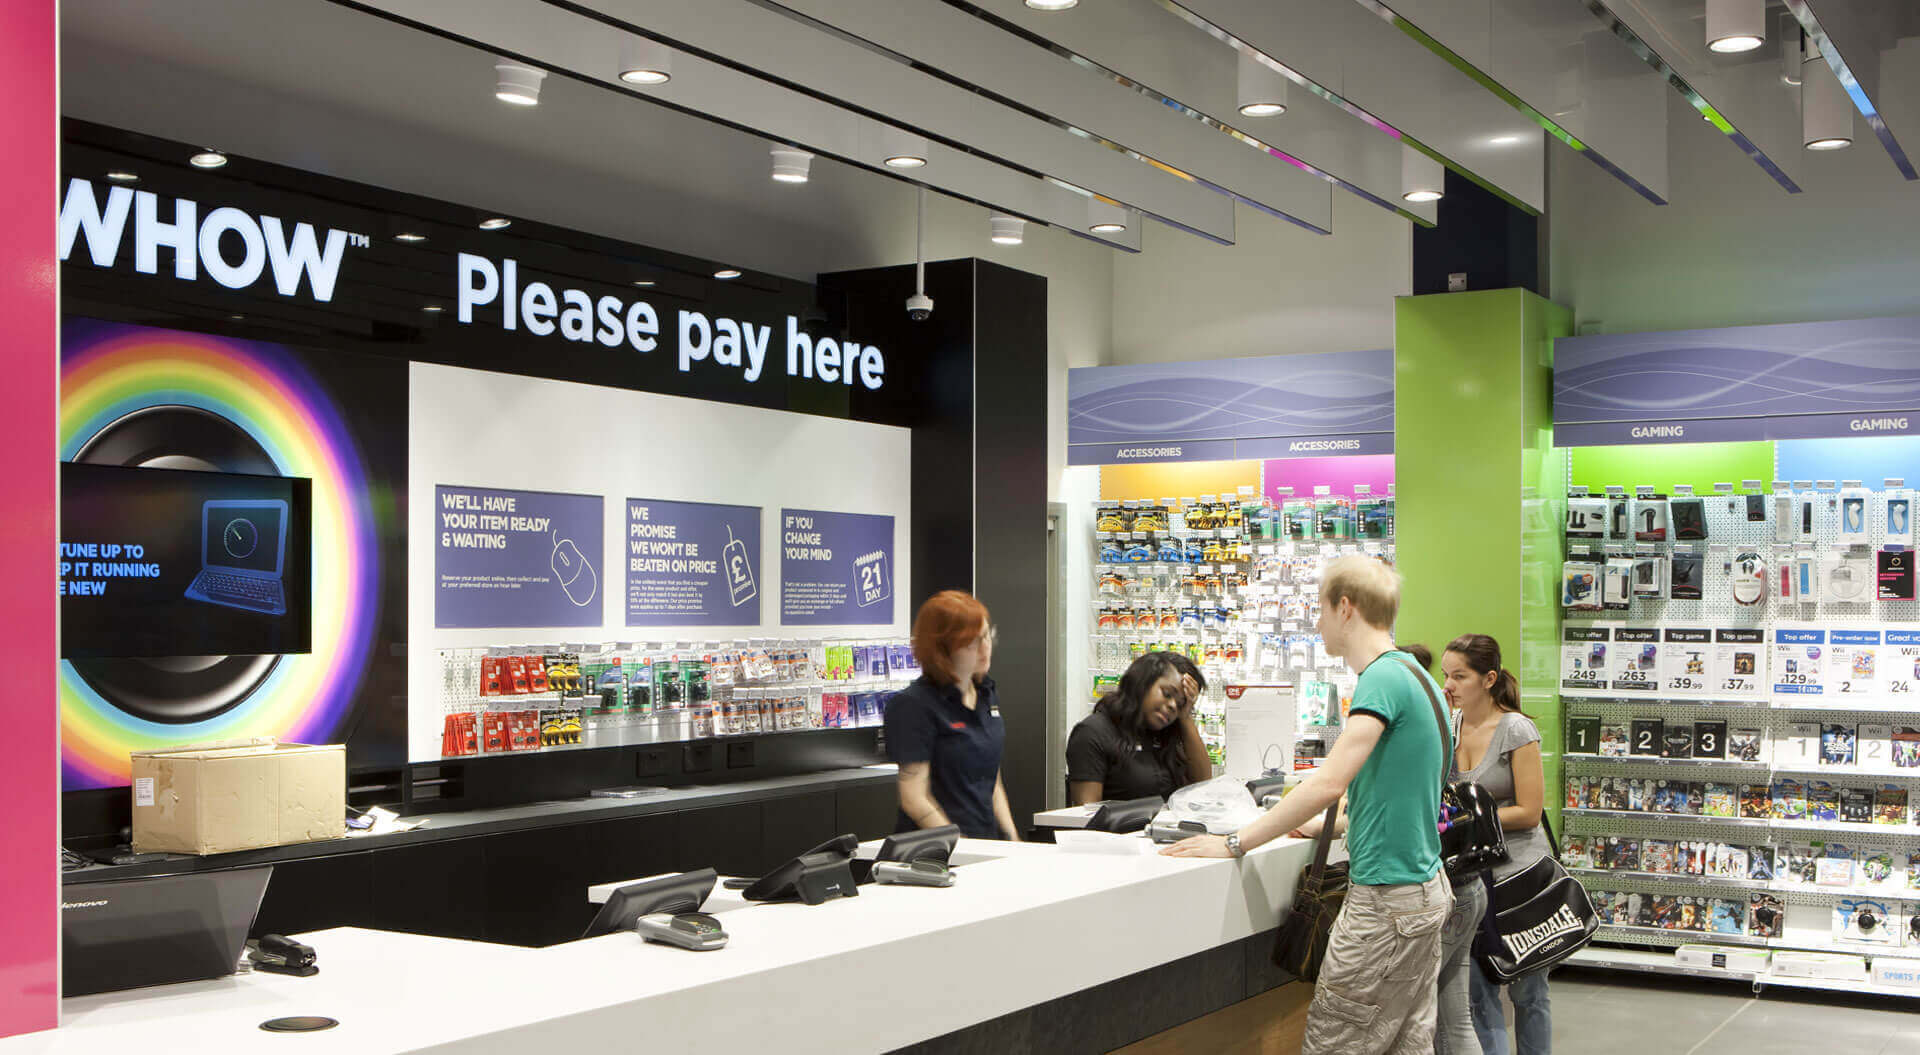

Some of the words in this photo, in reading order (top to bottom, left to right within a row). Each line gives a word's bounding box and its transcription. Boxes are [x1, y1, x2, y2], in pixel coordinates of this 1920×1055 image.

[457, 252, 659, 352] Please
[678, 309, 771, 382] pay
[787, 315, 885, 390] here
[1631, 425, 1684, 438] GAMING
[1850, 417, 1908, 432] GAMING
[1116, 447, 1182, 459] ACCESSORIES
[1289, 440, 1360, 452] ACCESSORIES
[442, 493, 481, 510] WE'LL
[483, 496, 516, 512] HAVE
[631, 505, 649, 520] WE
[442, 513, 480, 529] YOUR
[480, 514, 508, 530] ITEM
[510, 517, 550, 532] READY
[785, 516, 794, 529] IF
[795, 516, 814, 530] YOU
[631, 523, 676, 539] PROMISE
[785, 532, 821, 545] CHANGE
[441, 532, 450, 547] &
[452, 532, 506, 549] WAITING
[631, 541, 649, 555] WE
[650, 541, 684, 556] WON'T
[685, 543, 698, 556] BE
[60, 543, 97, 558] TUNE
[101, 544, 121, 558] UP
[123, 544, 144, 559] TO
[785, 547, 809, 560] YOUR
[810, 548, 832, 561] MIND
[75, 562, 90, 577] IT
[92, 562, 160, 578] RUNNING
[630, 558, 670, 573] BEATEN
[671, 559, 688, 573] ON
[689, 560, 717, 574] PRICE
[731, 555, 746, 583] £
[861, 562, 882, 591] 21
[69, 581, 106, 596] NEW
[865, 587, 881, 602] DAY
[1671, 632, 1684, 640] Top
[1901, 647, 1919, 656] Wii
[1577, 728, 1586, 747] 1
[1638, 730, 1652, 749] 2
[1701, 733, 1716, 752] 3
[1797, 738, 1806, 756] 1
[1867, 740, 1881, 758] 2
[1501, 903, 1584, 965] LONSDALE
[1539, 937, 1565, 954] LONDON
[1884, 972, 1913, 981] SPORTS
